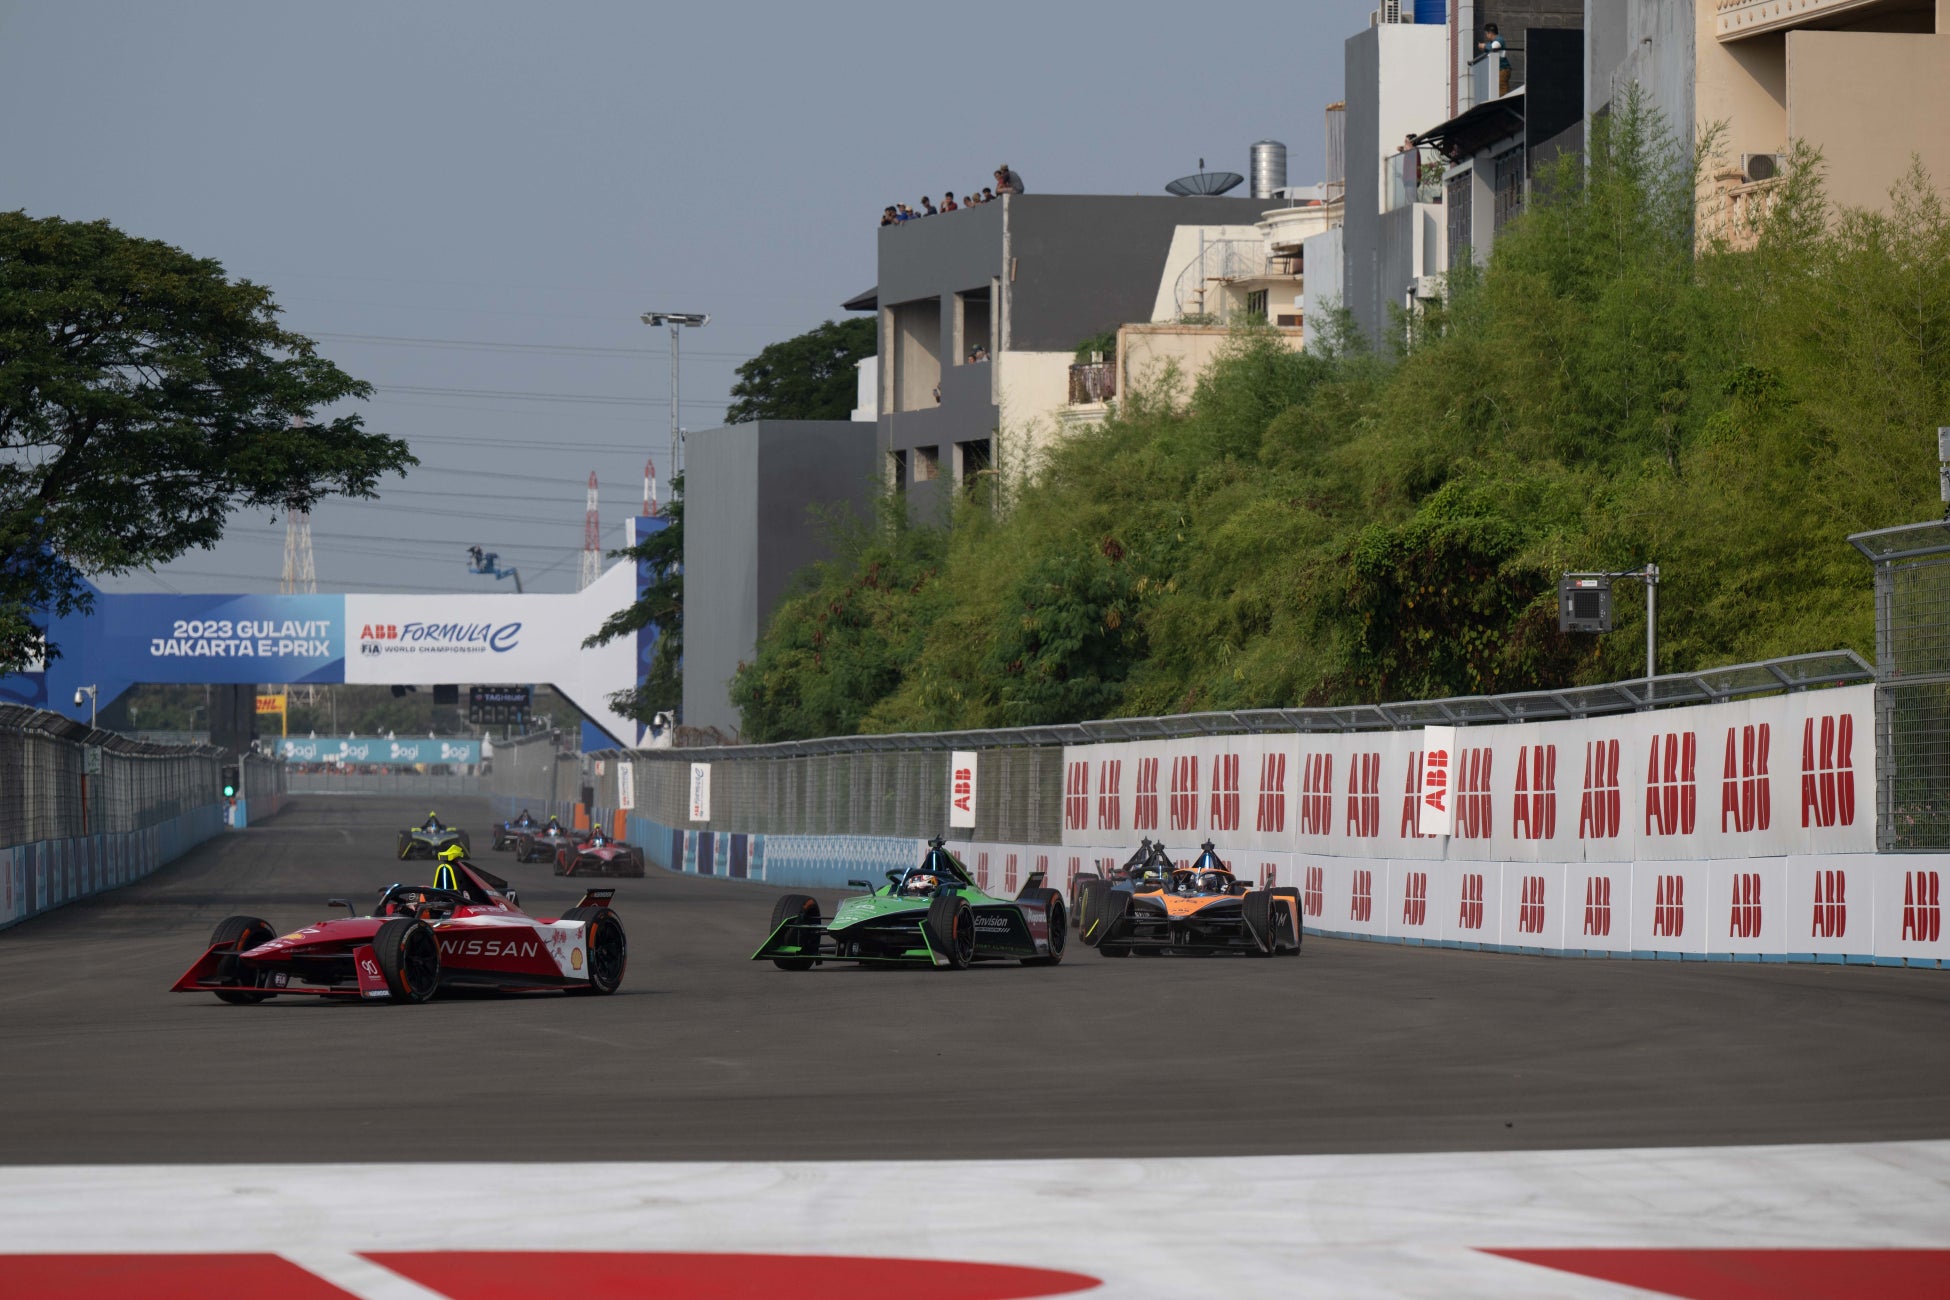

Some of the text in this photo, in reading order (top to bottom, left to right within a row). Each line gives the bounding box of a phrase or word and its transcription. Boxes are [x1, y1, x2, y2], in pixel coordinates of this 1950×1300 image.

[150, 639, 331, 657] JAKARTA E-PRIX
[173, 620, 331, 638] 2023 GULAVIT
[360, 624, 398, 640] ABB
[400, 622, 492, 643] FORMULA
[954, 768, 971, 812] ABB
[1066, 761, 1088, 829] ABB
[1099, 760, 1121, 829] ABB
[1134, 758, 1158, 829] ABB
[1171, 756, 1198, 830] ABB
[1211, 754, 1239, 830] ABB
[1257, 753, 1285, 832] ABB
[1302, 753, 1332, 835] ABB
[1347, 753, 1380, 837] ABB
[1425, 750, 1448, 812] ABB
[1456, 748, 1492, 838] ABB
[1513, 745, 1556, 839] ABB
[1579, 739, 1620, 838] ABB
[1646, 732, 1696, 835] ABB
[1722, 724, 1770, 832] ABB
[1801, 714, 1854, 828] ABB
[1005, 853, 1017, 894] ABB
[1305, 866, 1322, 917] ABB
[1352, 870, 1370, 922] ABB
[1404, 872, 1426, 925] ABB
[1460, 875, 1482, 928] ABB
[1520, 876, 1544, 933] ABB
[1584, 876, 1610, 935] ABB
[1654, 875, 1683, 937] ABB
[1730, 873, 1761, 938] ABB
[1812, 870, 1846, 938] ABB
[1902, 871, 1940, 941] ABB
[440, 940, 538, 957] NISSAN
[974, 915, 1008, 927] Envision
[361, 959, 378, 975] 90
